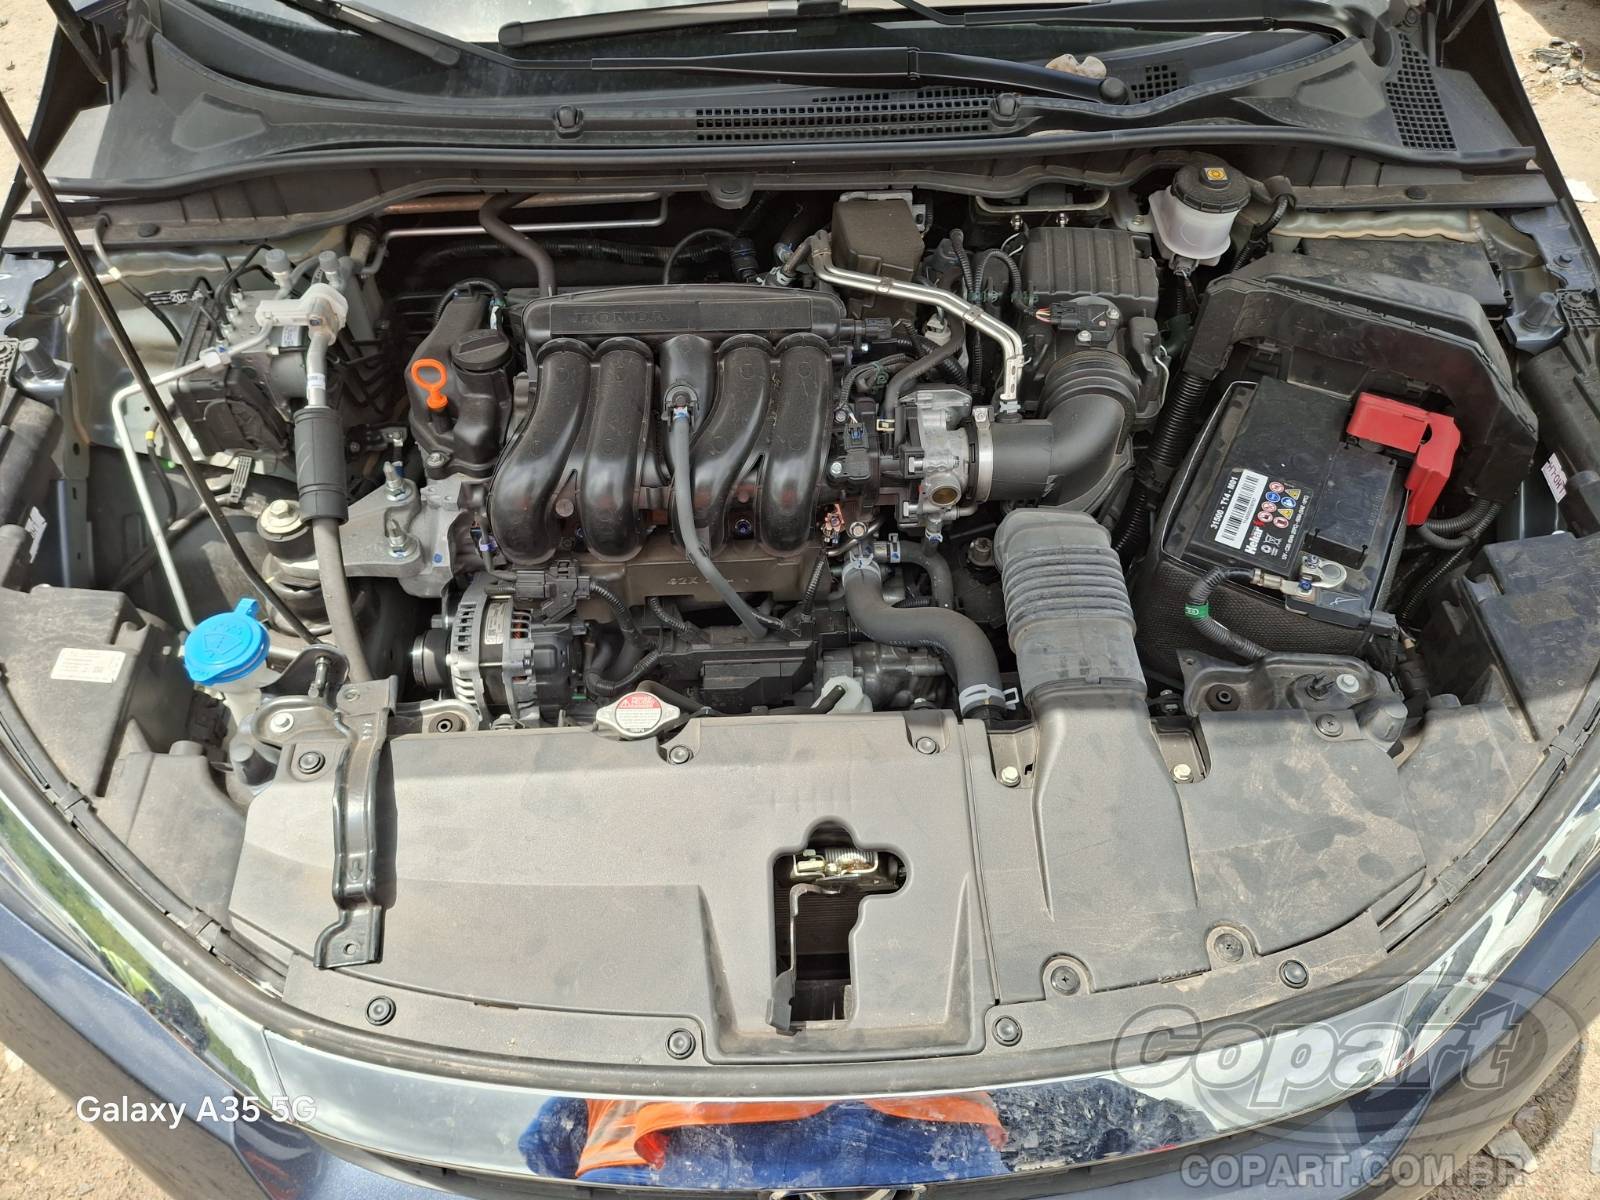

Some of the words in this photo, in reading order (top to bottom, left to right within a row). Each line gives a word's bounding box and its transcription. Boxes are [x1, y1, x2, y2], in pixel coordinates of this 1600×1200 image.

[1210, 509, 1224, 529] 31500
[1220, 492, 1231, 505] T14
[1244, 526, 1264, 555] Heliar
